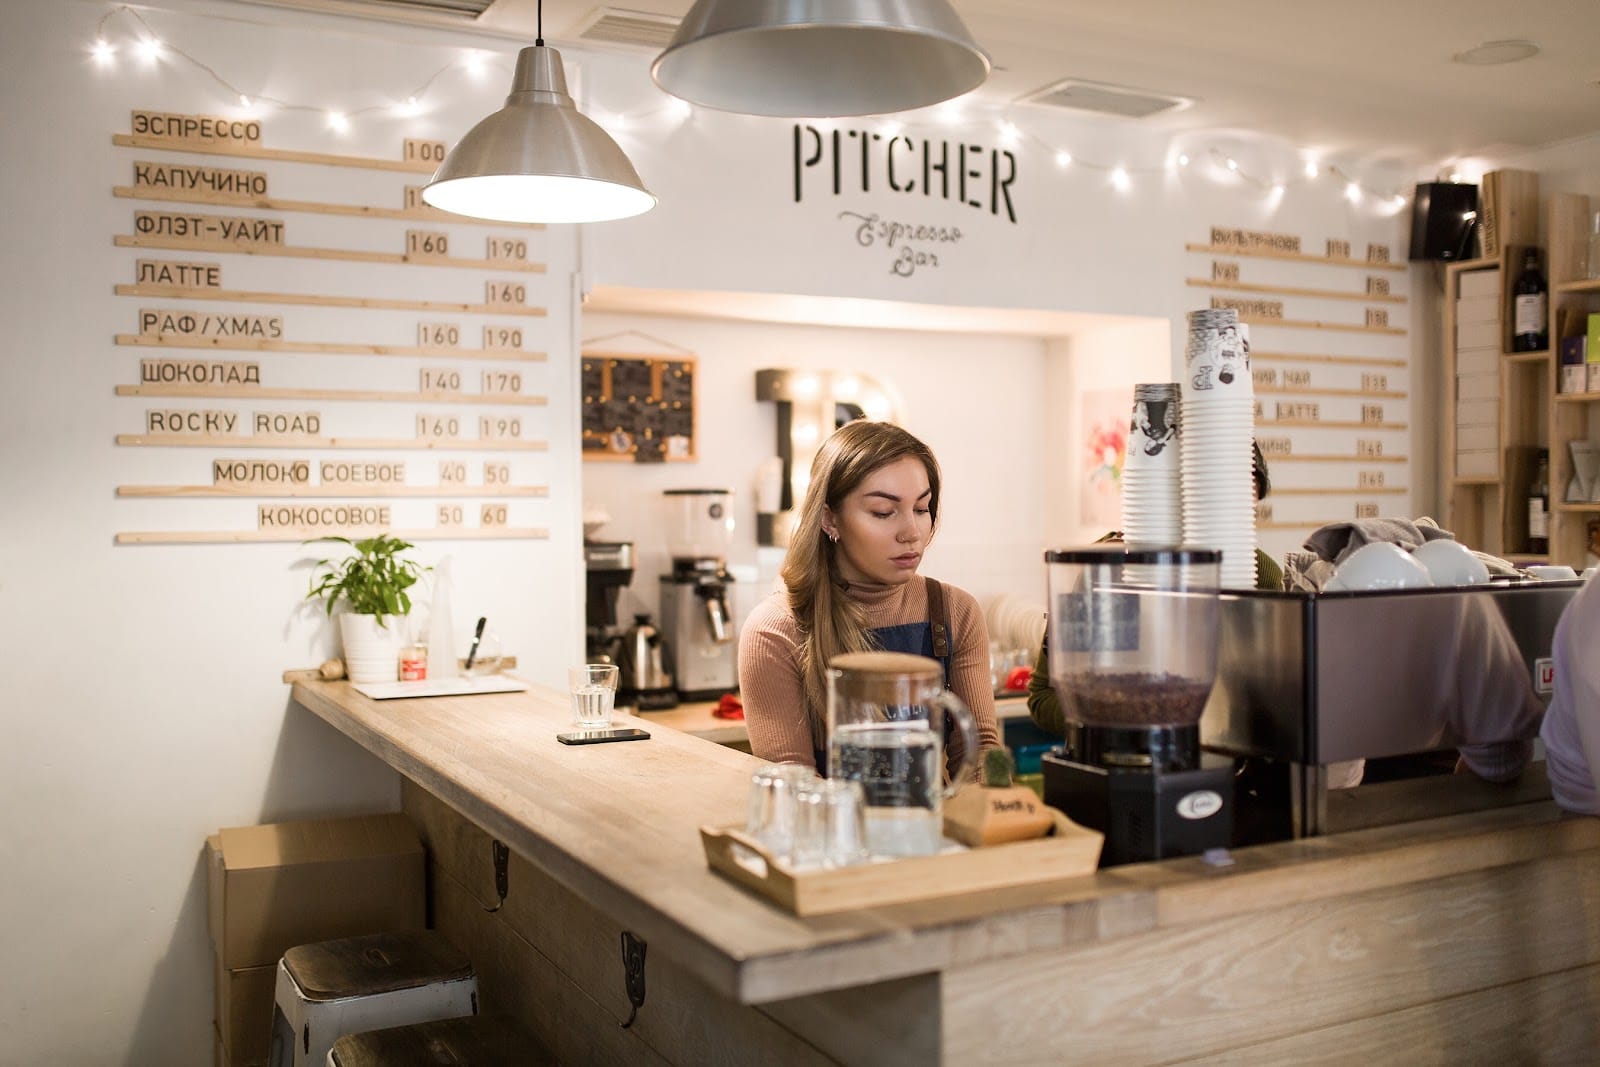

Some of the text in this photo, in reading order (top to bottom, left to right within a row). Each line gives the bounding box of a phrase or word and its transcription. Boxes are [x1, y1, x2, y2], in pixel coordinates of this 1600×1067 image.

[135, 114, 445, 161] ЭСПРЕССО 100
[135, 165, 267, 195] КАПУЧИНО
[794, 123, 1017, 224] PITCHER
[136, 215, 527, 260] ФЛЭТ-УАЙТ 160 190
[838, 210, 963, 248] Espresso
[889, 246, 939, 278] Bar
[138, 263, 526, 304] ЛАТТЕ 160
[143, 313, 522, 348] РАФ/XMAS 160 190
[142, 363, 521, 392] ШОКОЛАД 140 170
[150, 412, 520, 437] ROCKY ROAD 160 190
[215, 462, 510, 484] МОЛОКО СОЕВОЕ 40 50
[261, 506, 506, 526] КОКОСОВОЕ 50 60
